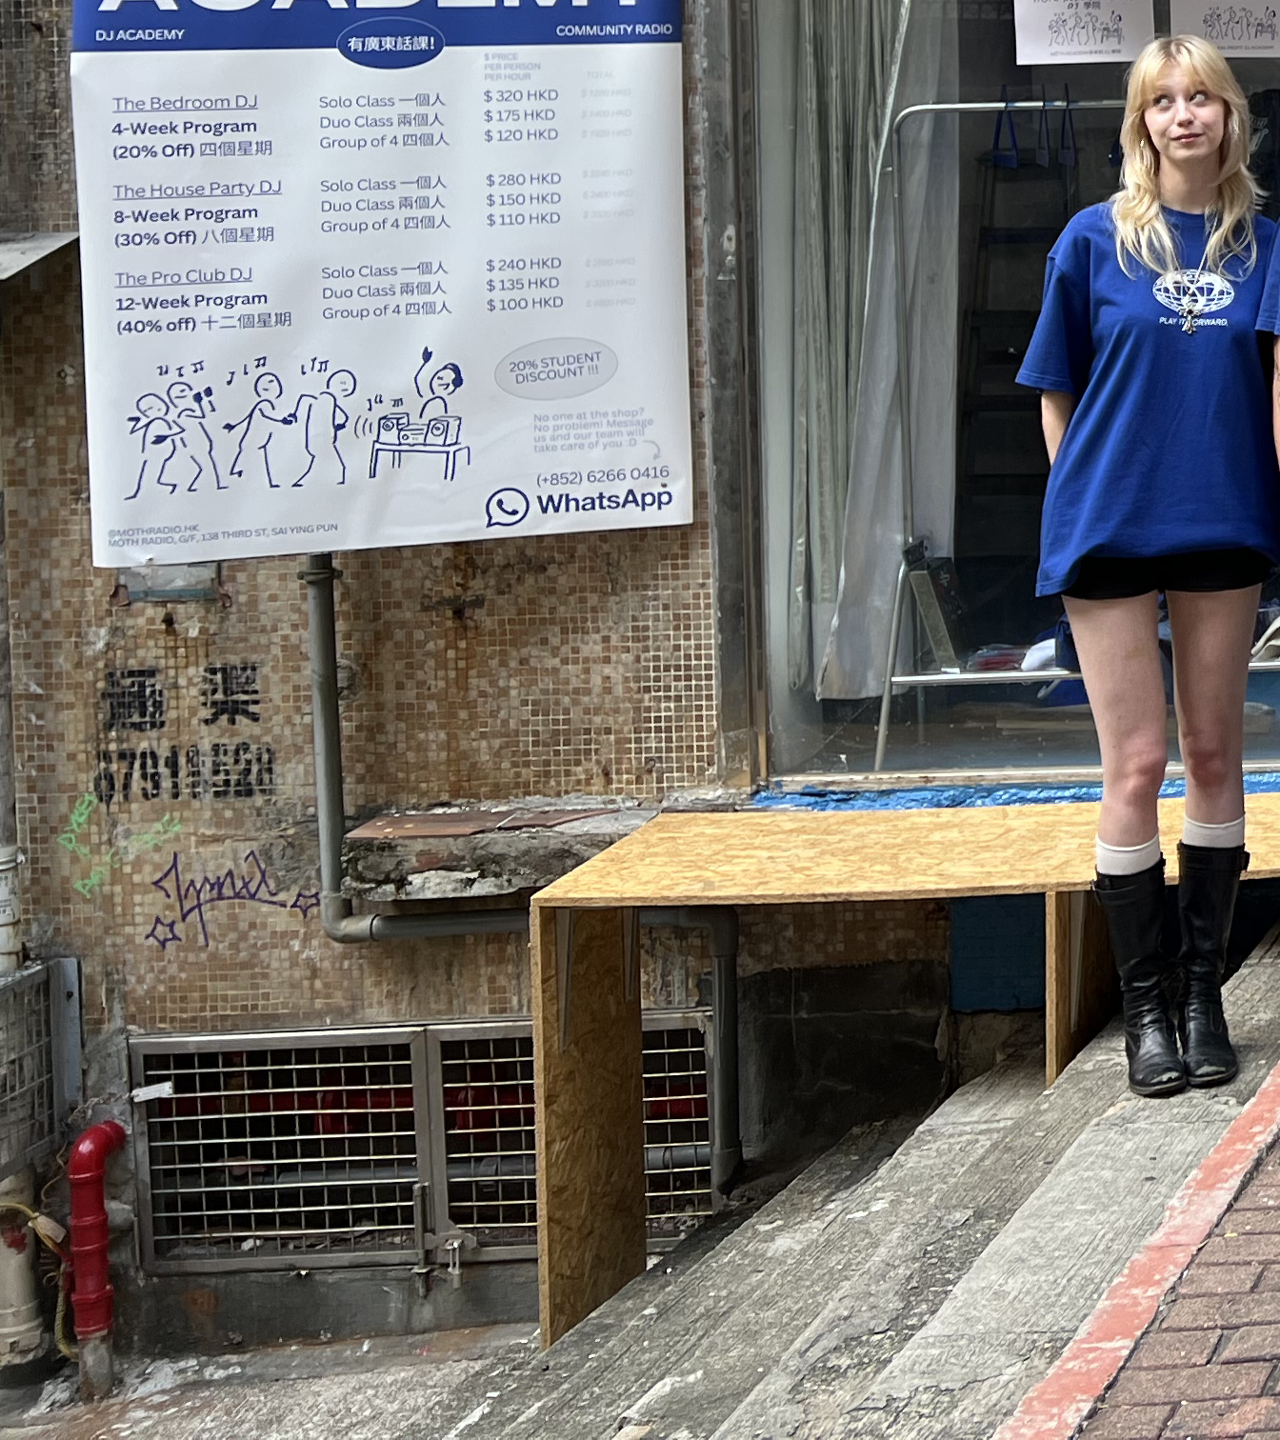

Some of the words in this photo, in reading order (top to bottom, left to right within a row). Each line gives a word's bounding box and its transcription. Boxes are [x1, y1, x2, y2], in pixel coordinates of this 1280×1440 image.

[95, 29, 114, 42] DJ
[116, 27, 185, 42] ACADEMY
[556, 24, 634, 37] COMMUNITY
[635, 23, 673, 35] RADIO
[484, 63, 502, 71] PER
[484, 73, 501, 81] PER
[504, 73, 531, 81] HOUR
[113, 97, 146, 111] The
[150, 96, 230, 110] Bedroom
[236, 95, 258, 109] DJ
[319, 95, 352, 108] Solo
[356, 95, 395, 107] Class
[399, 92, 446, 107] 一個人
[484, 90, 493, 103] $
[496, 90, 523, 102] 320
[527, 89, 559, 101] HKD
[320, 116, 351, 128] Duo
[354, 115, 394, 128] Class
[397, 112, 445, 127] 兩個人
[484, 109, 493, 123] $
[496, 110, 520, 122] 175
[524, 109, 556, 121] HKD
[112, 121, 179, 135] 4-Week
[183, 121, 257, 136] Program
[484, 129, 493, 143] $
[497, 129, 523, 142] 120
[527, 129, 558, 141] HKD
[113, 145, 158, 160] (20%
[162, 143, 195, 158] Off)
[200, 140, 273, 157] 四個星期
[320, 136, 367, 151] Group
[371, 134, 387, 147] of
[390, 135, 399, 146] 4
[402, 132, 450, 147] 四個人
[113, 185, 146, 198] The
[150, 183, 205, 197] House
[210, 182, 255, 197] Party
[260, 180, 282, 194] DJ
[320, 179, 353, 192] Solo
[357, 178, 397, 191] Class
[400, 175, 447, 190] 一個人
[321, 200, 352, 212] Duo
[355, 199, 395, 211] Class
[398, 195, 446, 211] 兩個人
[114, 208, 180, 224] 8-Week
[185, 207, 258, 223] Program
[321, 220, 369, 234] Group
[372, 217, 389, 230] of
[390, 218, 400, 230] 4
[404, 215, 451, 230] 四個人
[114, 232, 160, 248] (30%
[164, 230, 197, 245] Off)
[202, 227, 275, 244] 八個星期
[115, 272, 147, 286] The
[152, 271, 181, 284] Pro
[186, 268, 225, 283] Club
[230, 267, 253, 281] DJ
[116, 295, 190, 310] 12-Week
[194, 293, 268, 309] Program
[117, 320, 162, 335] (40%
[166, 317, 196, 332] off)
[201, 311, 292, 331] 十二個星期
[509, 360, 538, 373] 20%
[541, 351, 602, 369] STUDENT
[515, 366, 584, 384] DISCOUNT
[533, 413, 549, 423] No
[552, 413, 573, 422] one
[576, 411, 587, 420] at
[590, 409, 608, 419] the
[611, 407, 645, 420] shop?
[534, 435, 546, 443] us
[550, 432, 570, 442] and
[573, 432, 592, 441] our
[596, 429, 623, 439] team
[626, 426, 645, 437] will
[534, 443, 558, 453] take
[560, 441, 585, 451] care
[588, 440, 599, 450] of
[602, 440, 623, 450] you
[536, 471, 583, 488] (+852)
[587, 468, 626, 483] 6266
[630, 465, 670, 480] 0416
[536, 489, 673, 514] WhatsApp
[141, 536, 177, 546] RADIO,
[179, 534, 199, 544] G/F,
[202, 532, 219, 542] 138
[222, 530, 253, 540] THIRD
[255, 528, 270, 538] ST,
[271, 527, 288, 536] SAI
[289, 525, 314, 535] YING
[316, 523, 338, 533] PUN
